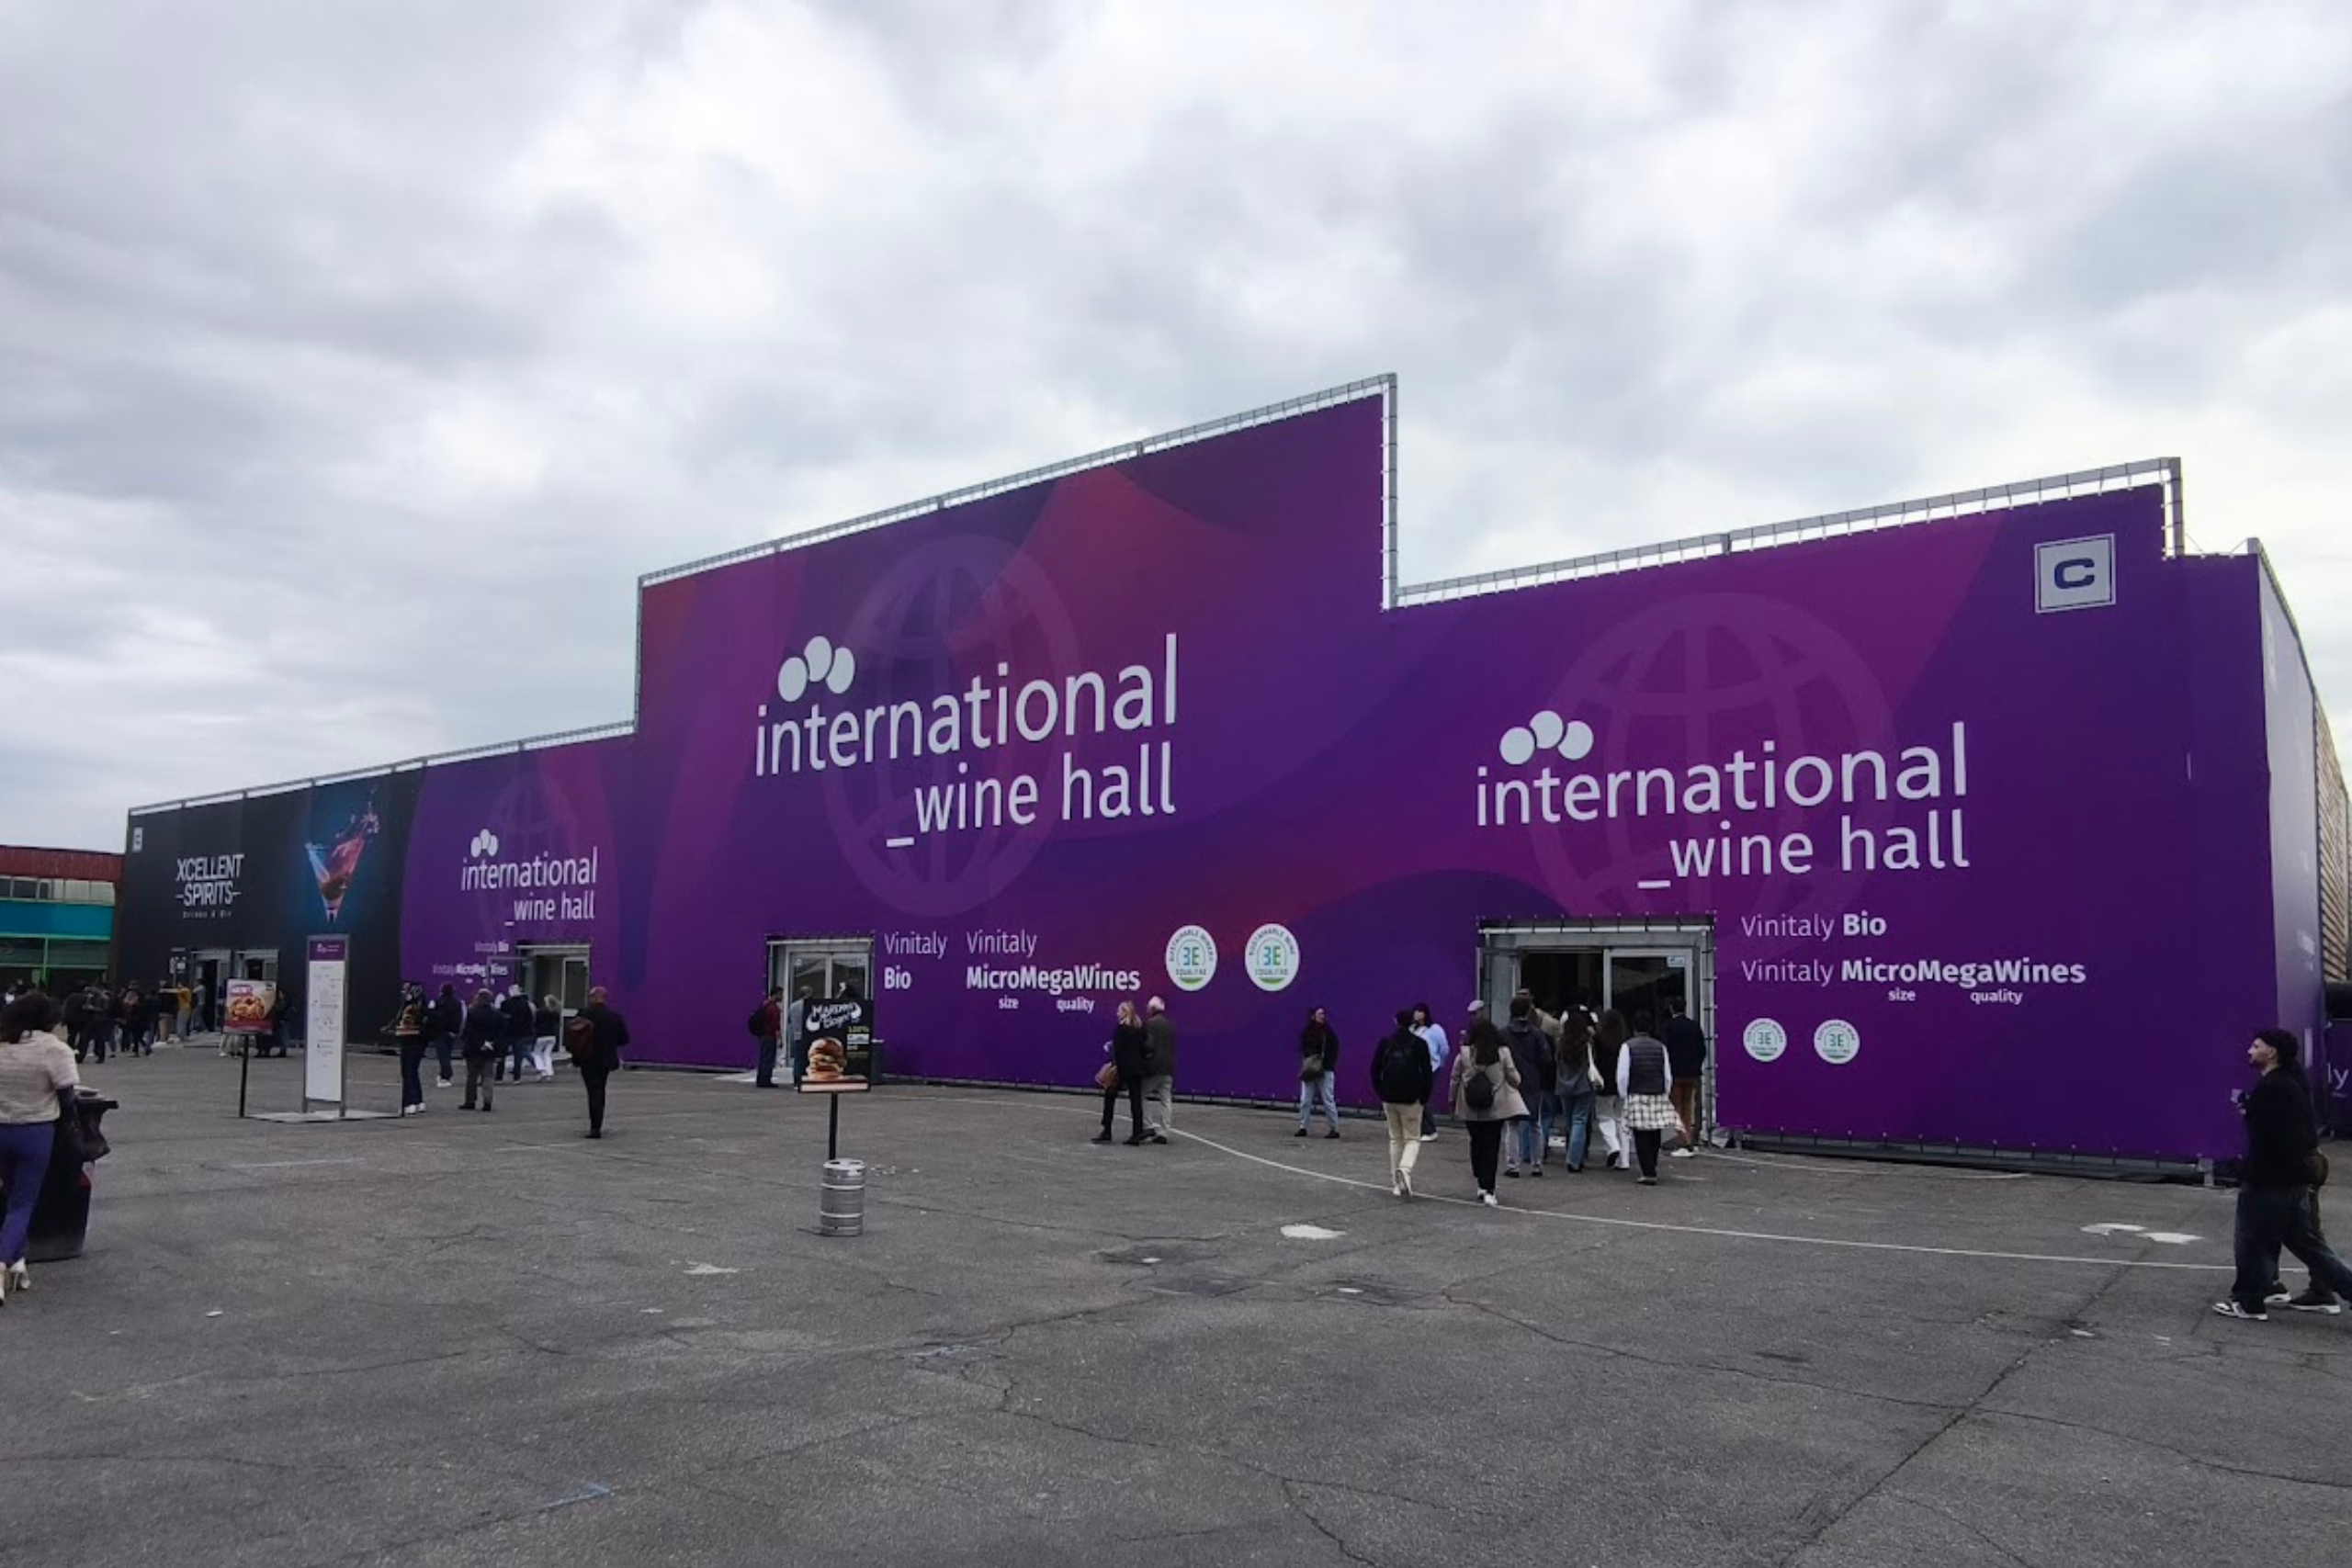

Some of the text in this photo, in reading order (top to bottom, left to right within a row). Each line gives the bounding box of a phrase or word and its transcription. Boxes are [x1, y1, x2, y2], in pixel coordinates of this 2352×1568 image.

[2054, 558, 2096, 590] C
[756, 633, 1177, 777] international
[1063, 741, 1176, 820] hall
[1477, 721, 1967, 827] international
[1841, 808, 1970, 872] hall
[175, 853, 245, 882] XCELLENT
[461, 845, 597, 890] international
[560, 889, 595, 920] hall
[1741, 909, 1887, 942] Vinitaly Bio
[884, 931, 948, 960] Vinitaly
[967, 929, 1037, 958] Vinitaly
[1182, 946, 1200, 966] 3E
[1263, 945, 1282, 966] 3E
[884, 964, 911, 989] Bio
[967, 963, 1141, 996] MicroMegaWines
[1741, 956, 2086, 989] Vinitaly MicroMegaWines
[998, 995, 1019, 1010] size
[1057, 995, 1095, 1013] quality
[1888, 987, 1917, 1001] size
[1970, 988, 2023, 1005] quality
